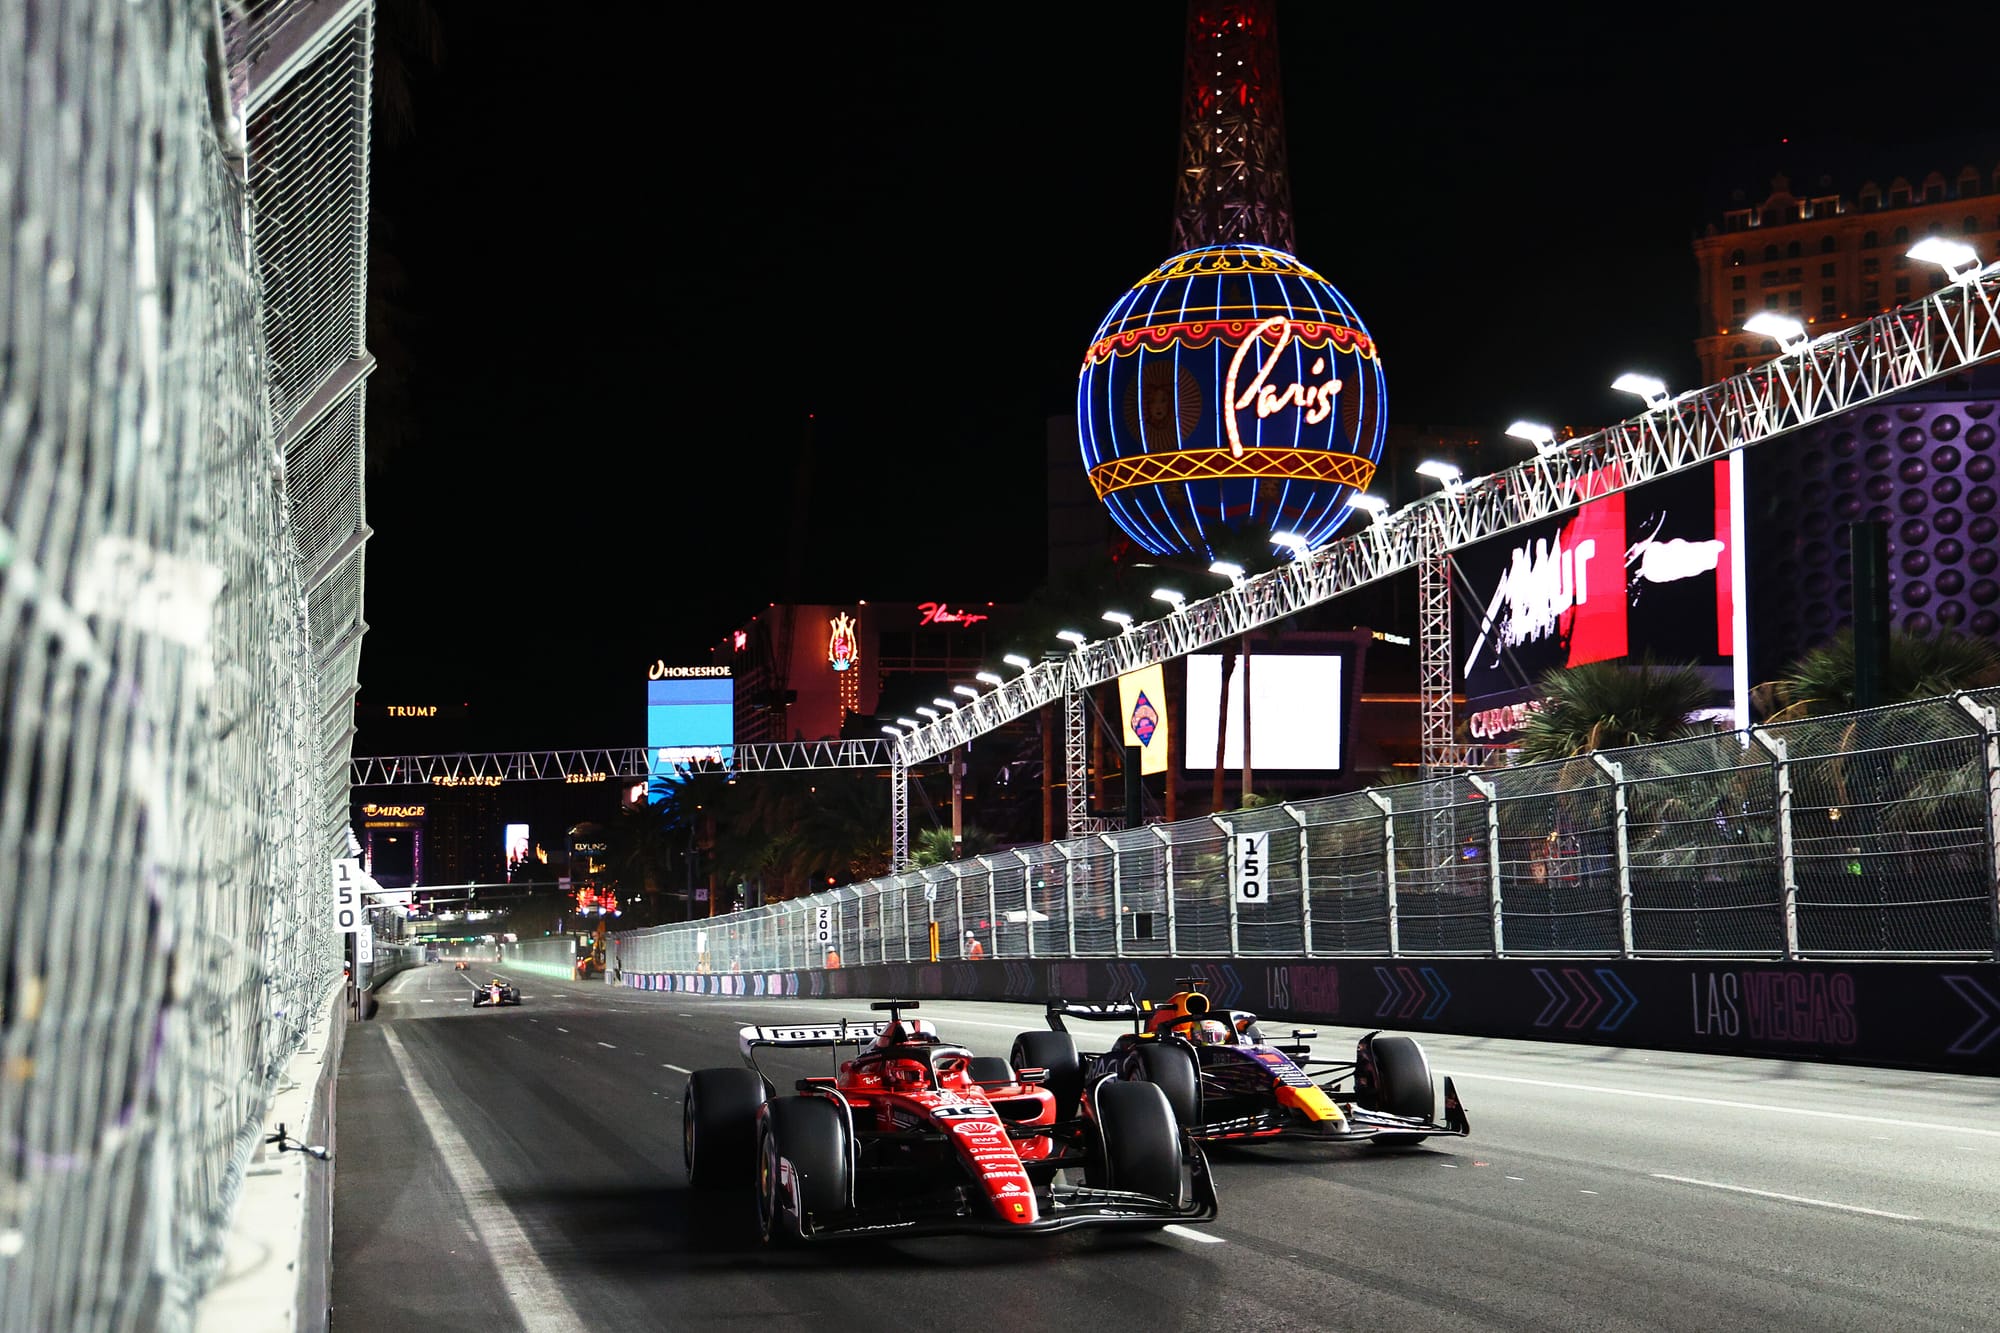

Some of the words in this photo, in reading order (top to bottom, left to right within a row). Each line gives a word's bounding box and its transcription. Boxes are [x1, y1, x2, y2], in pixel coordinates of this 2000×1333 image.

[1225, 316, 1343, 458] Paris
[917, 602, 988, 627] Flamingo
[664, 666, 732, 677] HORSESHOE
[387, 706, 437, 717] TRUMP
[432, 776, 502, 786] TREASURE
[565, 773, 606, 784] ISLAND
[368, 806, 425, 817] MIRAGE
[1243, 838, 1260, 899] 150
[338, 863, 354, 928] 150
[819, 909, 829, 941] 200
[1266, 966, 1289, 1010] LAS
[1691, 966, 1740, 1037] LAS
[1742, 970, 1858, 1045] VEGAS
[930, 1105, 995, 1118] 16
